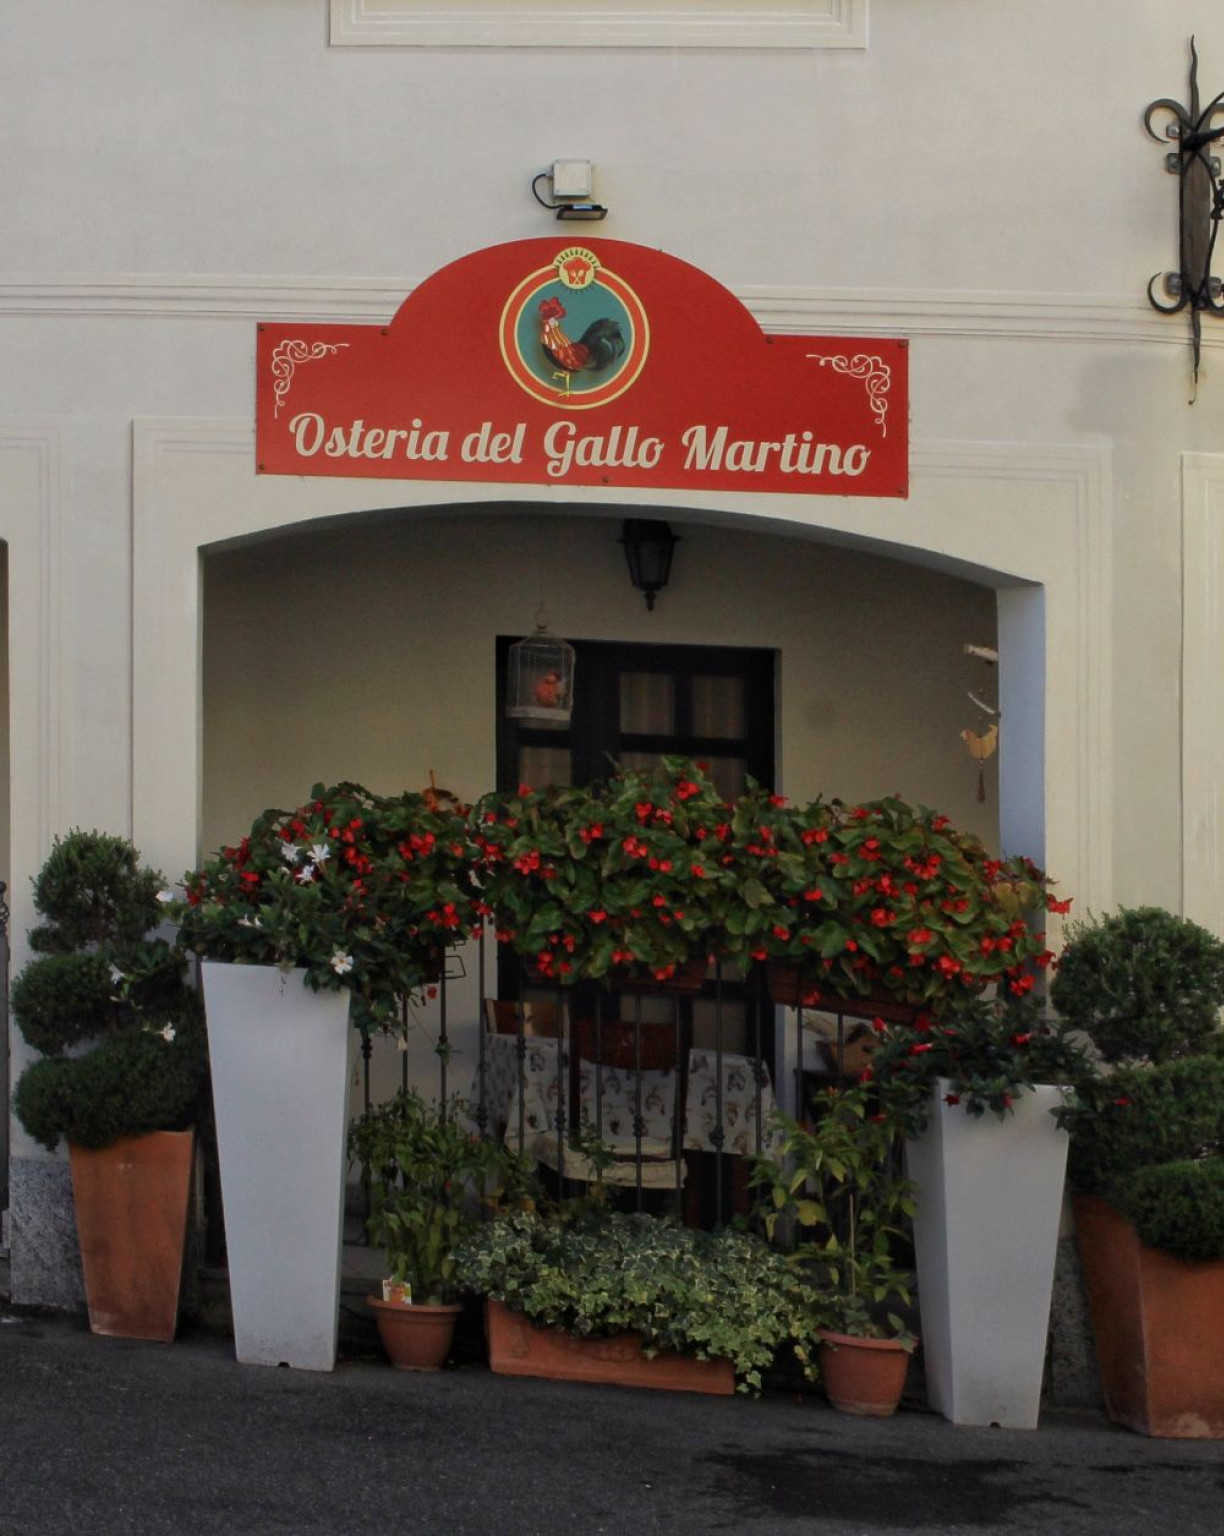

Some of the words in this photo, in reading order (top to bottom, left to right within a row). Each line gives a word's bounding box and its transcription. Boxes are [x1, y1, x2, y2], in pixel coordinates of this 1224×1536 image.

[288, 412, 449, 461] Osteria
[461, 421, 526, 465] del
[543, 420, 665, 477] Gallo
[681, 425, 871, 477] Martino
